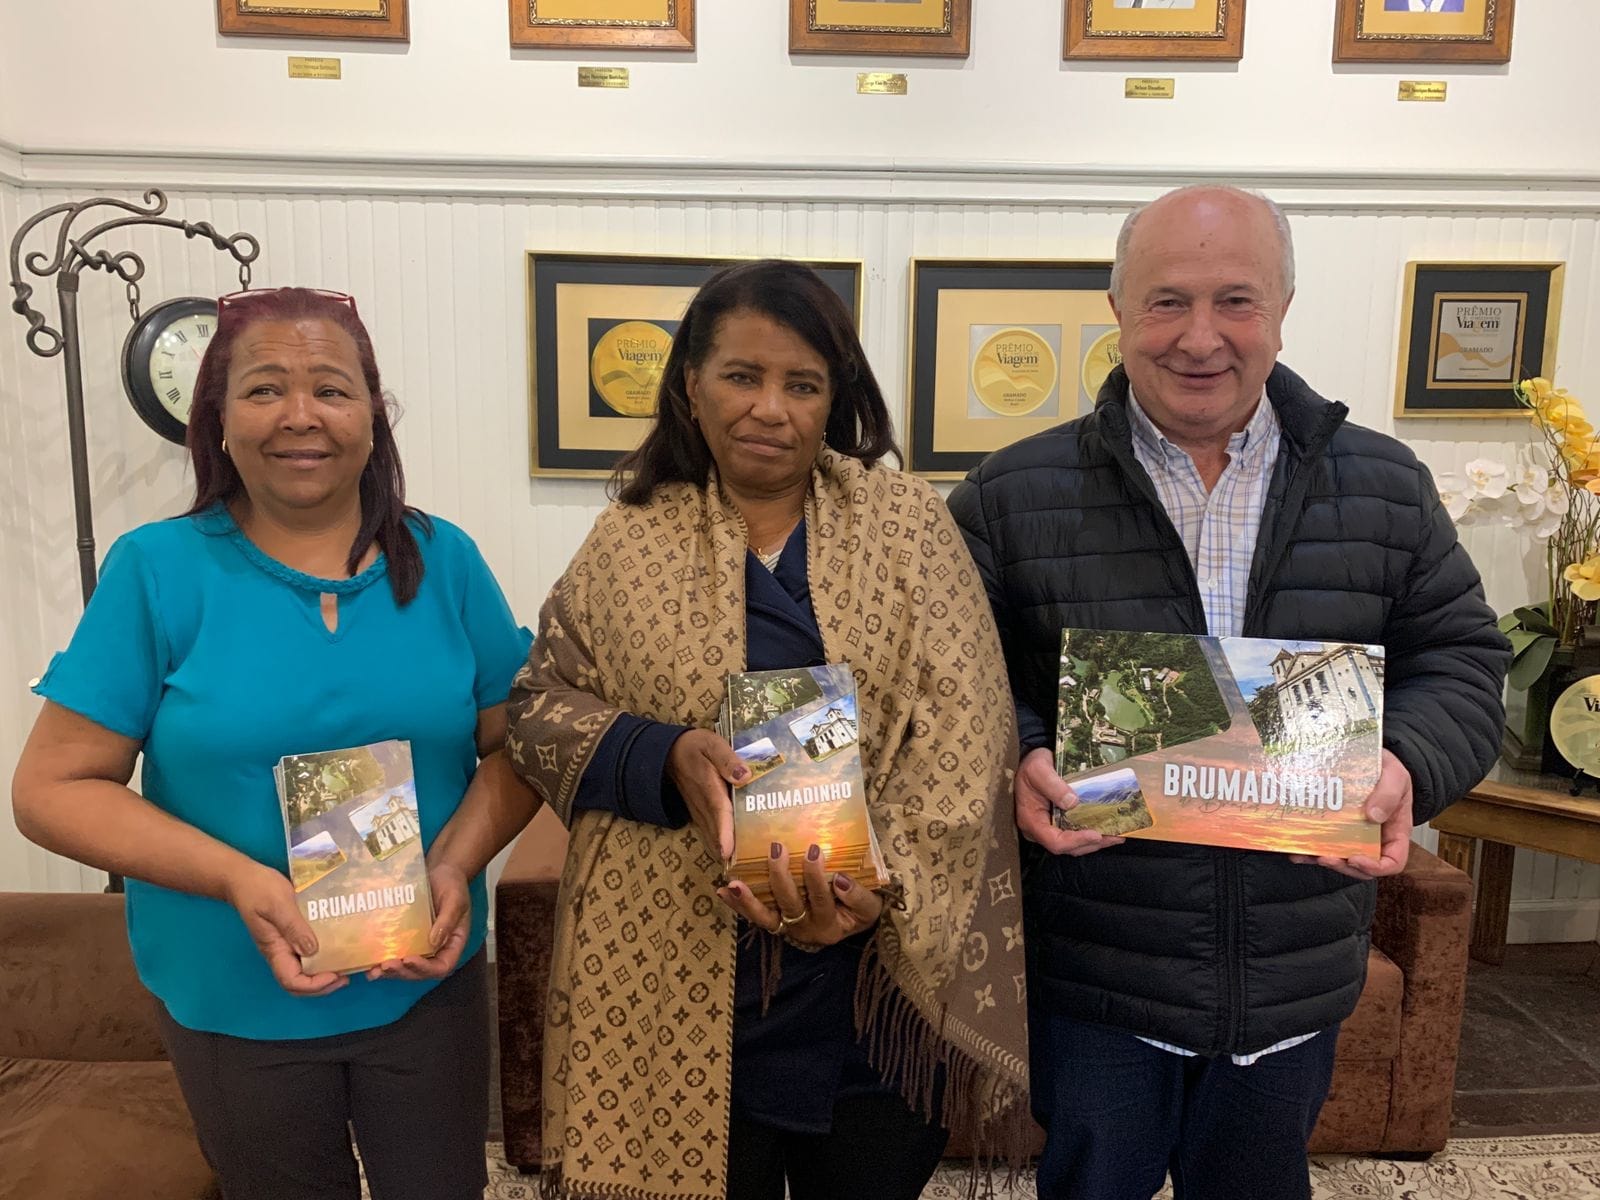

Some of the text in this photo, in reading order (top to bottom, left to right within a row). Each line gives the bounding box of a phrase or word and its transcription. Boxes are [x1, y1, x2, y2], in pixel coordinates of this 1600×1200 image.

[1456, 305, 1502, 316] PRÊMIO
[616, 337, 657, 348] PRÊMIO
[996, 342, 1034, 352] PRÊMIO
[617, 348, 662, 366] Viagem
[997, 352, 1038, 368] Viagem
[1164, 763, 1344, 811] BRUMADINHO
[745, 781, 852, 812] BRUMADINHO
[307, 883, 416, 921] BRUMADINHO
